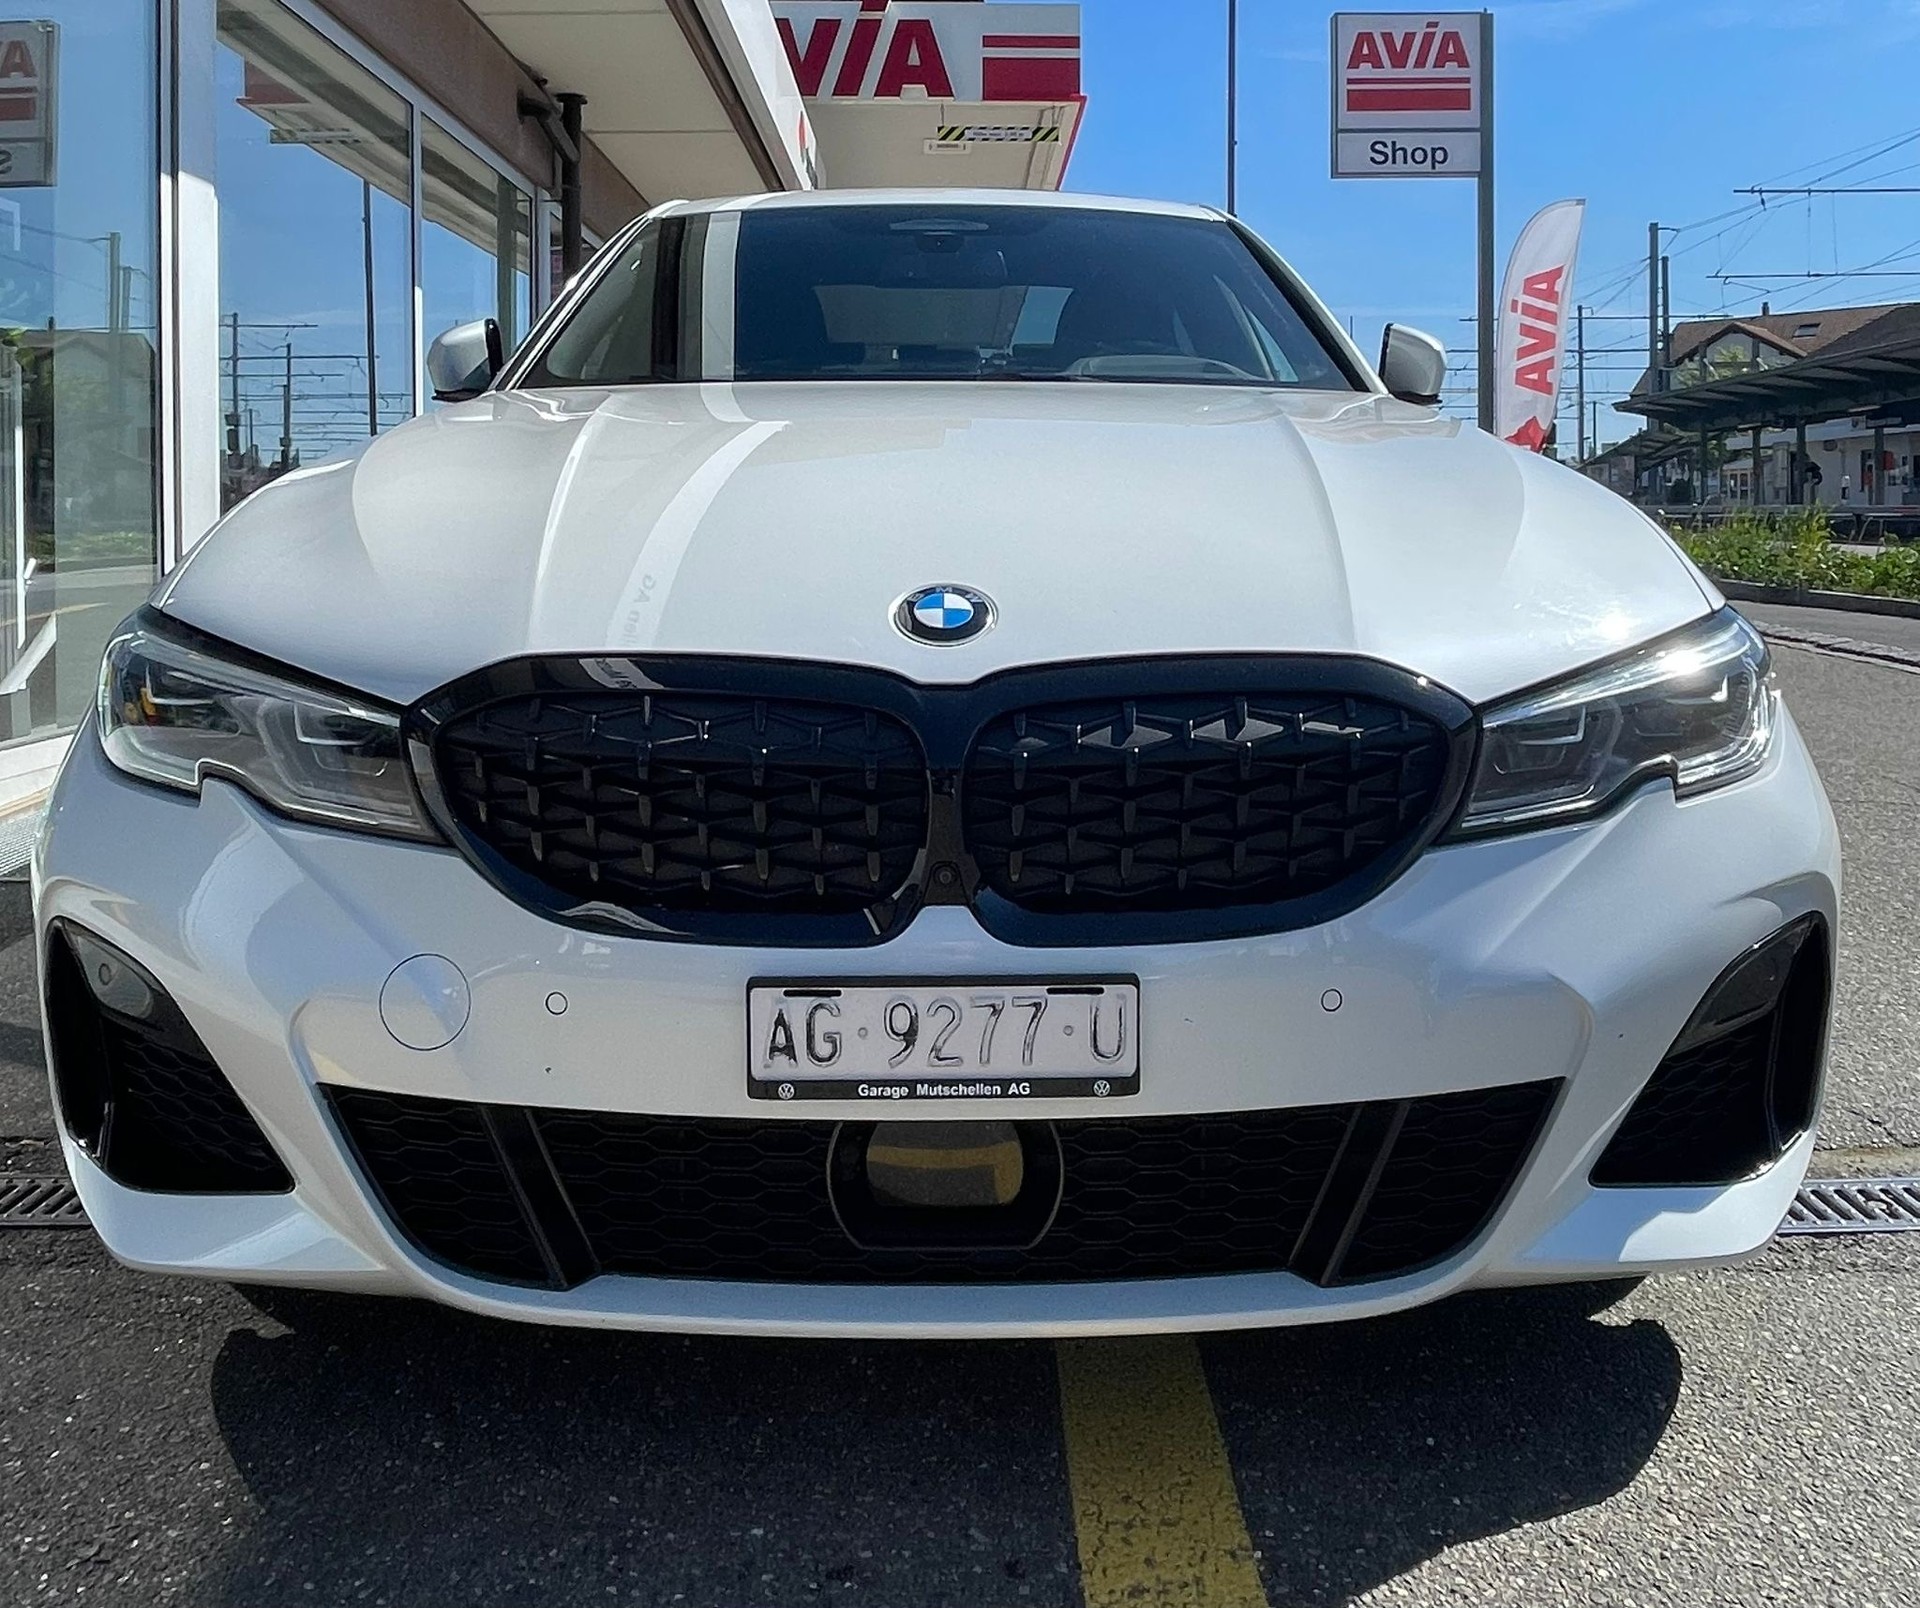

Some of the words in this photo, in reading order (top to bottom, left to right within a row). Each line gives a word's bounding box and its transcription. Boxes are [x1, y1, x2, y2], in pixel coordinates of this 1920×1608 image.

[1369, 140, 1449, 170] Shop
[765, 997, 842, 1069] AG
[883, 995, 1048, 1068] 9277
[1089, 993, 1127, 1063] U
[858, 1084, 909, 1099] Garage
[916, 1083, 1001, 1096] Mutschellen
[1007, 1083, 1031, 1096] AG
